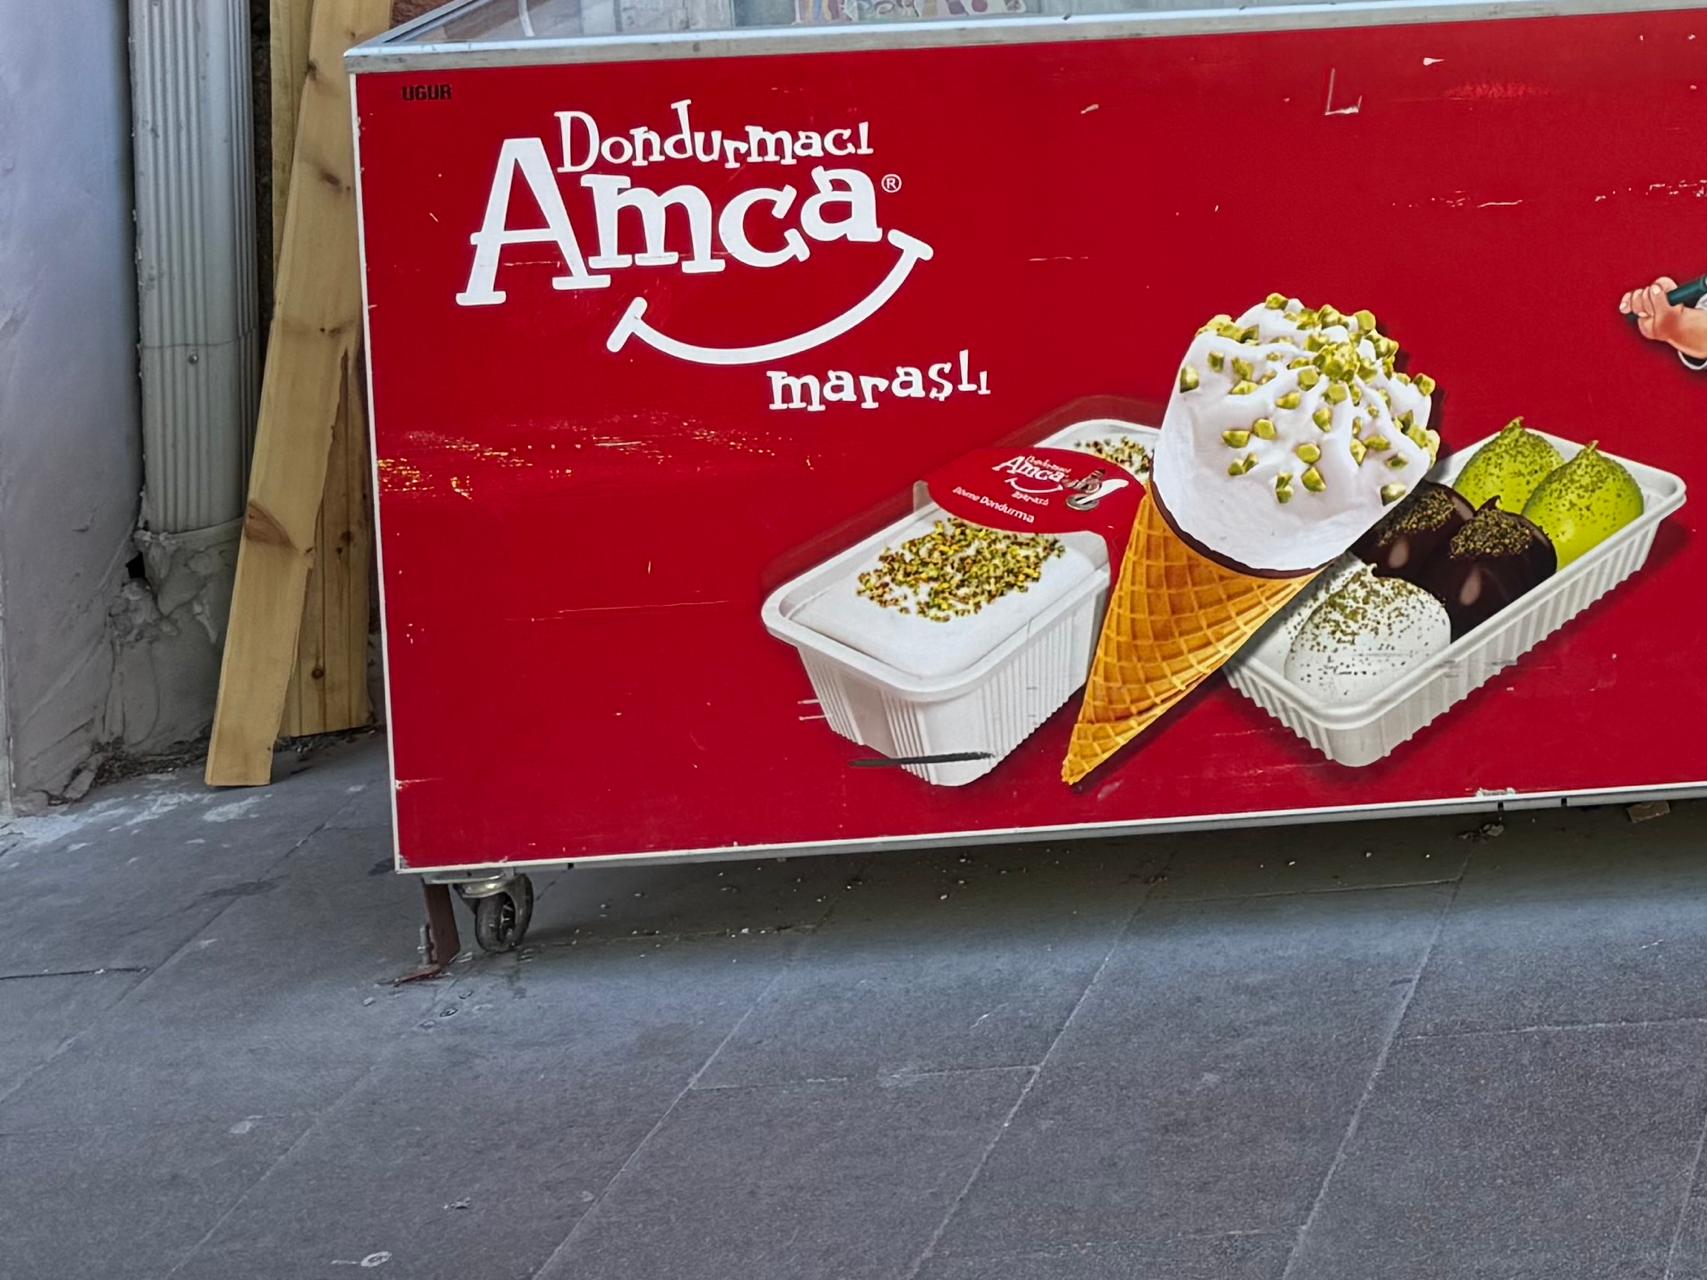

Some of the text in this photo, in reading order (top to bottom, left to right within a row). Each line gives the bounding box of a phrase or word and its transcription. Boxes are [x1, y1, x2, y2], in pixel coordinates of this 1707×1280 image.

[554, 99, 873, 174] Dondurmacı
[455, 137, 883, 306] Amca
[766, 349, 992, 413] maraşlı
[992, 456, 1066, 482] Amca
[980, 495, 1035, 524] Dondurma
